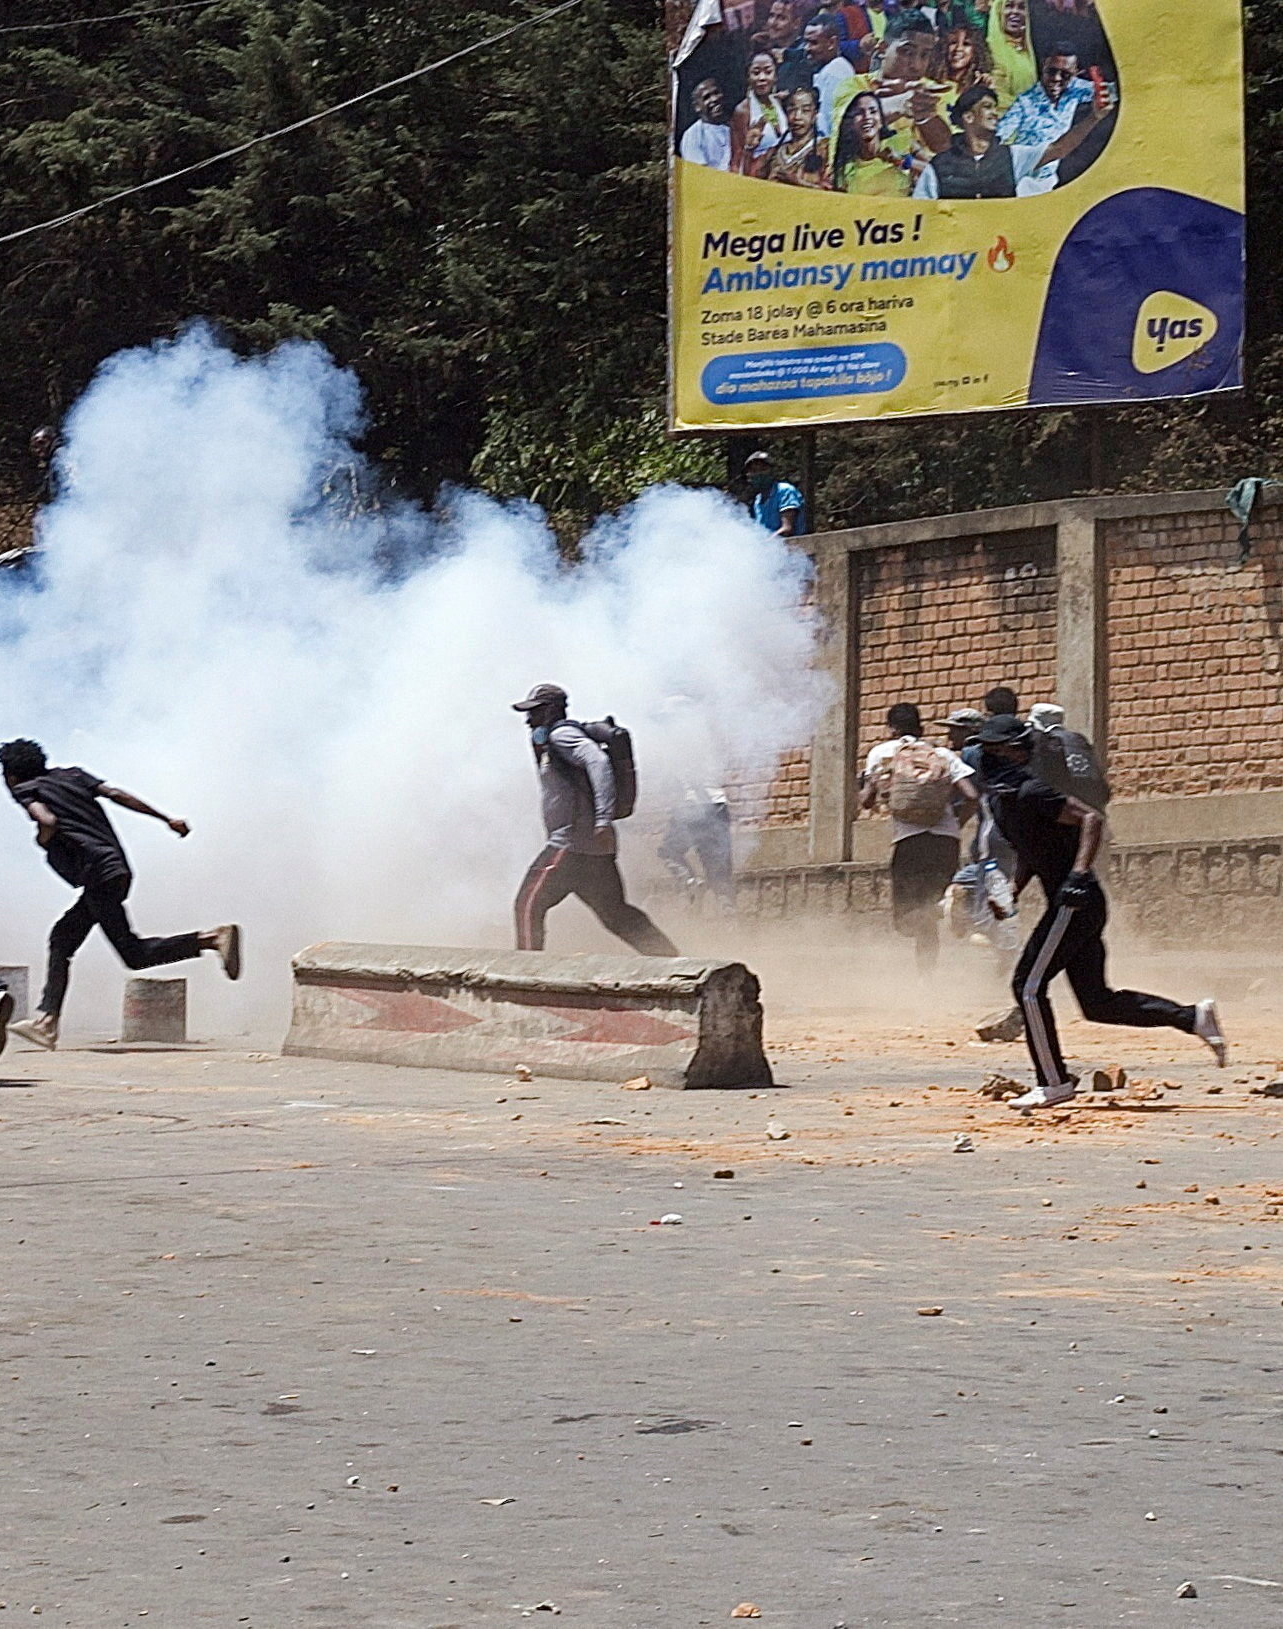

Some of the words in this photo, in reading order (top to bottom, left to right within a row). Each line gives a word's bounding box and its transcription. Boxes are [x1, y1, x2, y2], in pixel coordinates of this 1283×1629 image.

[702, 231, 785, 262] Mega
[792, 223, 845, 252] live
[853, 217, 905, 247] Yas
[912, 214, 923, 241] !
[701, 262, 854, 295] Ambiansy
[860, 251, 979, 282] mamay
[701, 309, 743, 325] Zoma
[746, 304, 763, 320] 18
[765, 302, 804, 324] jolay
[806, 300, 824, 318] @
[826, 299, 837, 315] 6
[839, 300, 865, 314] ora
[867, 294, 915, 312] hariva
[701, 330, 744, 347] Stade
[747, 326, 790, 343] Barea
[792, 320, 887, 339] Mahamasina
[1147, 317, 1204, 353] yas
